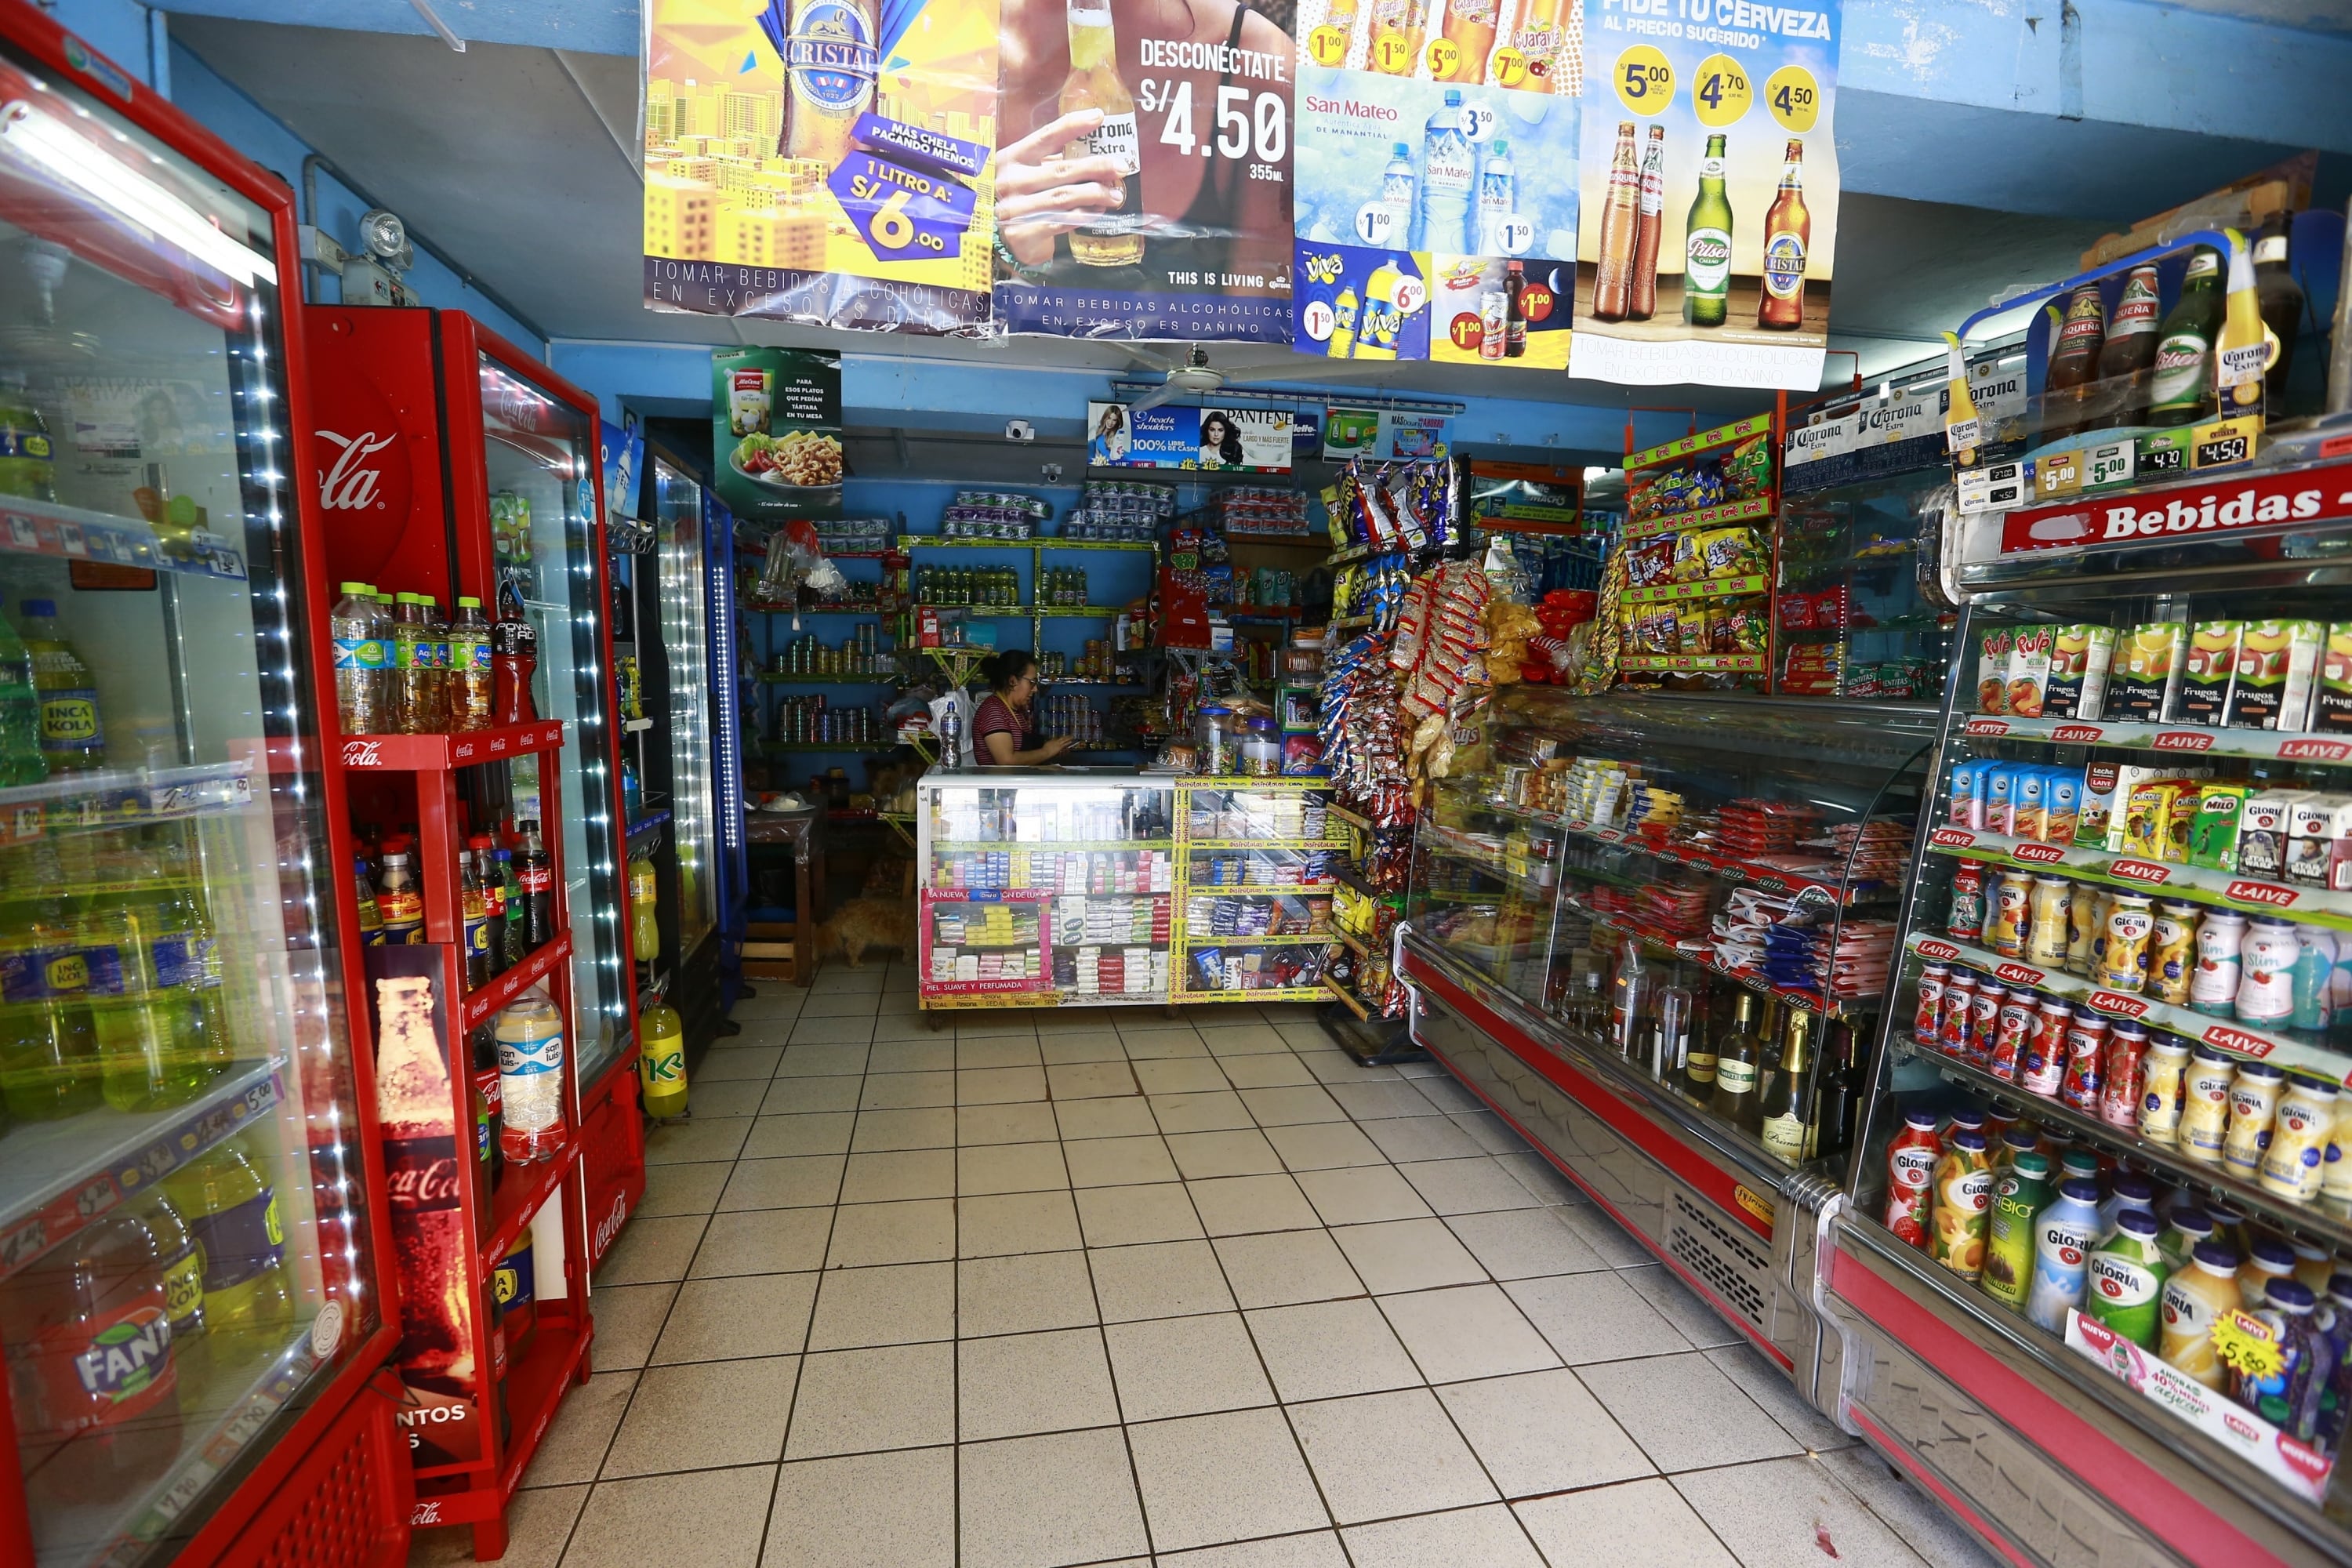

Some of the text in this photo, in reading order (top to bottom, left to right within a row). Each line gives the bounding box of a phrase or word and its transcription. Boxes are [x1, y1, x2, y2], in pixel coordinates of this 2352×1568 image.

[1604, 19, 1622, 31] AL
[1626, 20, 1683, 38] PRECIO
[1678, 0, 1711, 21] TU
[1715, 1, 1831, 40] CERVEZA
[1513, 24, 1561, 49] Guaraná
[790, 41, 873, 74] CRISTAL
[1306, 96, 1398, 121] San Mateo
[891, 122, 958, 154] MÁS CHELA
[1332, 129, 1388, 140] MANANTIAL
[872, 126, 975, 169] PAGANDO MENOS
[1090, 140, 1125, 154] Extra
[1249, 164, 1284, 182] 355ML
[1427, 165, 1472, 180] San Mateo
[868, 160, 952, 203] 1 LITRO A:
[1687, 238, 1731, 260] Pilsen
[1765, 257, 1806, 273] CRISTAL
[652, 259, 724, 284] TOMAR
[740, 267, 829, 294] BEBIDAS
[1167, 271, 1264, 288] THIS IS LIVING
[653, 282, 983, 332] EN EXCESO ES DAÑINO
[1003, 294, 1294, 318] TOMAR BEBIDAS ALCOHÓLICAS
[1042, 315, 1259, 333] EN EXCESO ES DAÑINO
[1580, 337, 1820, 367] TOMAR BEBIDAS ALCOHÓLICAS
[1604, 361, 1784, 384] EN EXCESO ES DAÑINO
[1226, 408, 1294, 426] PANTENE
[1391, 415, 1404, 425] MÁS
[1423, 418, 1445, 428] AHORRO
[1870, 404, 1922, 429] Corona
[1136, 423, 1174, 431] shoulders
[1886, 423, 1904, 431] Extra
[1951, 420, 1978, 436] Corona
[1797, 425, 1842, 448] Corona
[1958, 431, 1975, 441] Extra
[1132, 439, 1167, 452] 100%
[2155, 450, 2180, 465] 4.70
[2102, 489, 2323, 539] Bebidas
[2016, 628, 2051, 658] Pulp
[2048, 684, 2075, 694] Frugos
[2126, 686, 2157, 696] Frugos
[2183, 688, 2219, 698] Frugos
[2235, 690, 2274, 701] Frugos
[47, 705, 90, 720] INCA
[45, 717, 93, 734] KOLA
[2055, 728, 2100, 742] LAIVE
[2158, 735, 2209, 750] LAIVE
[456, 742, 474, 757] Coca-Cola
[2282, 742, 2345, 759] LAIVE
[2205, 800, 2234, 811] MILO
[2298, 811, 2331, 824] GLORIA
[2016, 845, 2060, 863] LAIVE
[1689, 859, 1711, 870] suiza
[2114, 863, 2165, 881] LAIVE
[2245, 859, 2274, 869] WARS
[518, 873, 548, 884] Coca-Cola
[1721, 867, 1744, 879] suiza
[1758, 877, 1783, 890] suiza
[2231, 884, 2293, 905] LAIVE
[2114, 916, 2147, 931] GLORIA
[2248, 952, 2280, 967] Slim
[1998, 965, 2041, 984] LAIVE
[2092, 994, 2145, 1015] LAIVE
[545, 1043, 559, 1054] san
[2207, 1029, 2271, 1055] LAIVE
[546, 1051, 558, 1062] luis
[1722, 1069, 1747, 1080] MISTELA
[1898, 1156, 1933, 1172] GLORIA
[594, 1189, 627, 1261] Coca-Cola
[2104, 1256, 2131, 1272] yogurt
[2092, 1258, 2140, 1292] GLORIA
[2081, 1320, 2111, 1341] NUEVO
[2223, 1341, 2267, 1373] 5.50
[2160, 1368, 2191, 1390] AHORA
